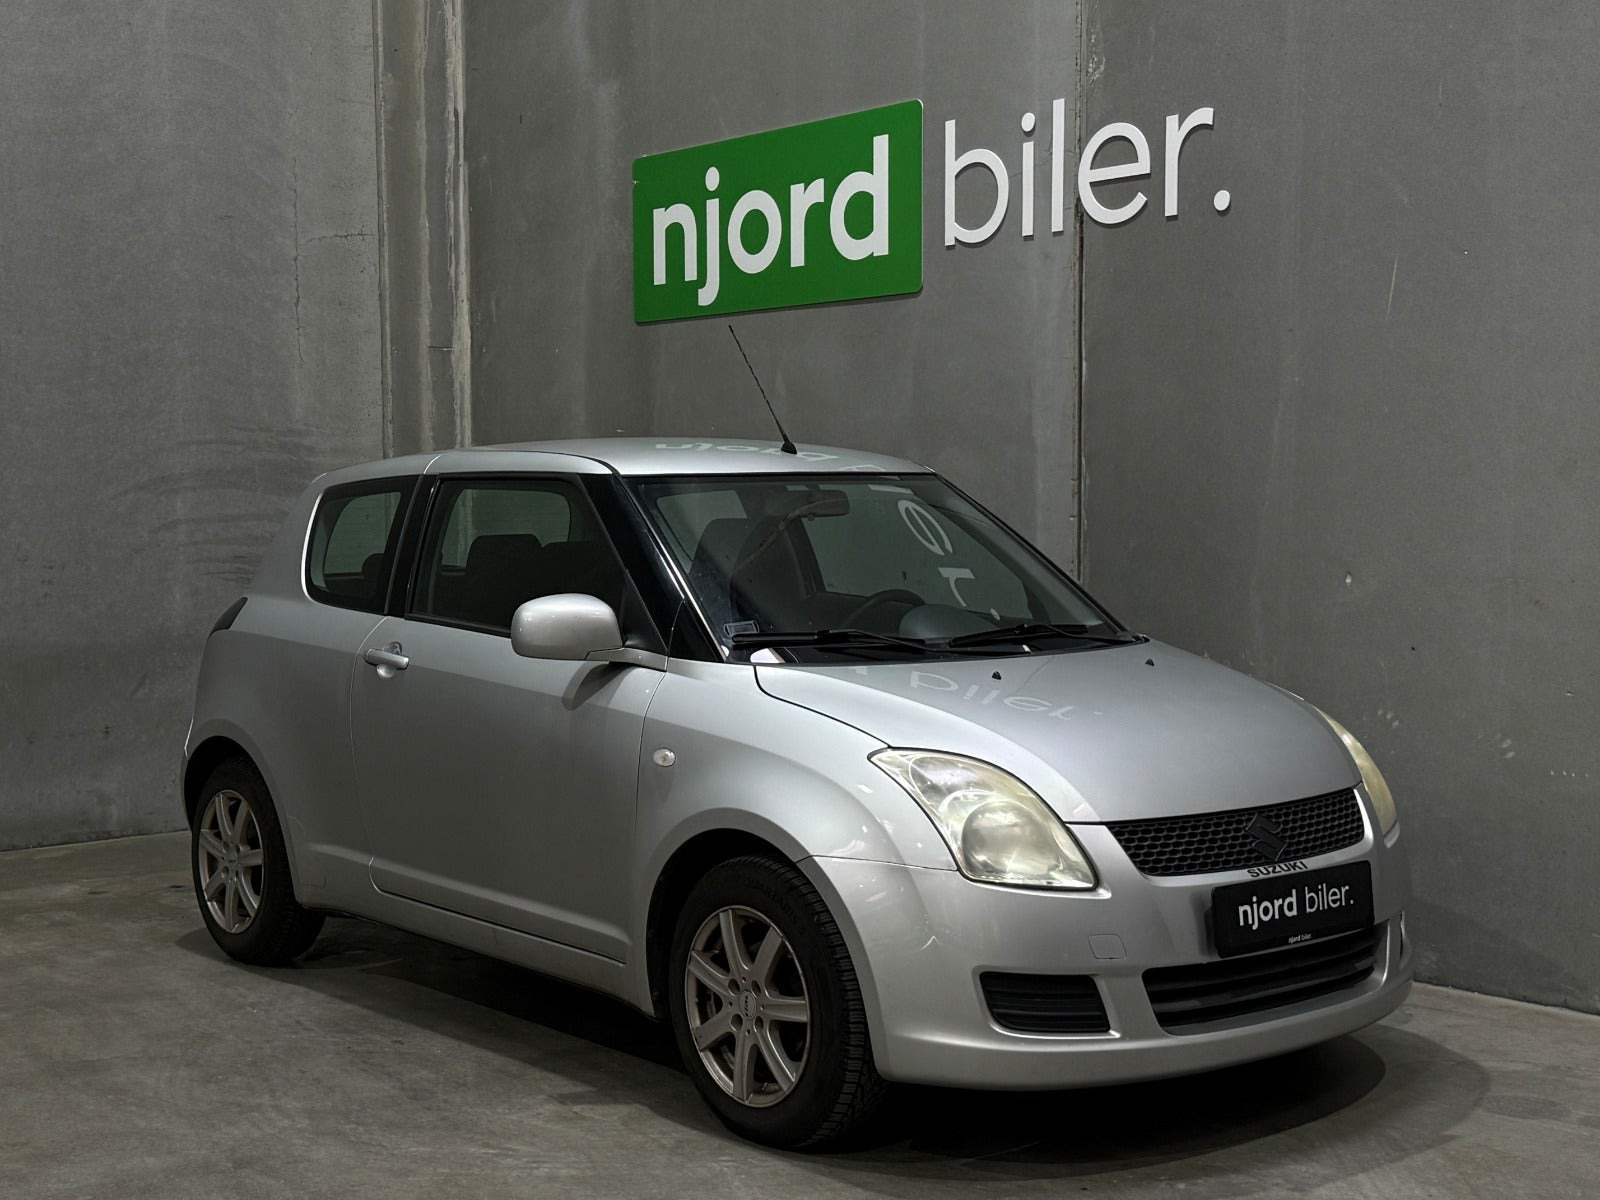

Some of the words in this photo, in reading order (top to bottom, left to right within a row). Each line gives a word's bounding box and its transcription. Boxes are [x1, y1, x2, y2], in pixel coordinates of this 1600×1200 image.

[653, 134, 889, 306] njord
[944, 97, 1231, 246] biler.
[1247, 860, 1308, 878] SUZUKI
[1238, 888, 1298, 930] njord
[1304, 883, 1354, 913] biler.
